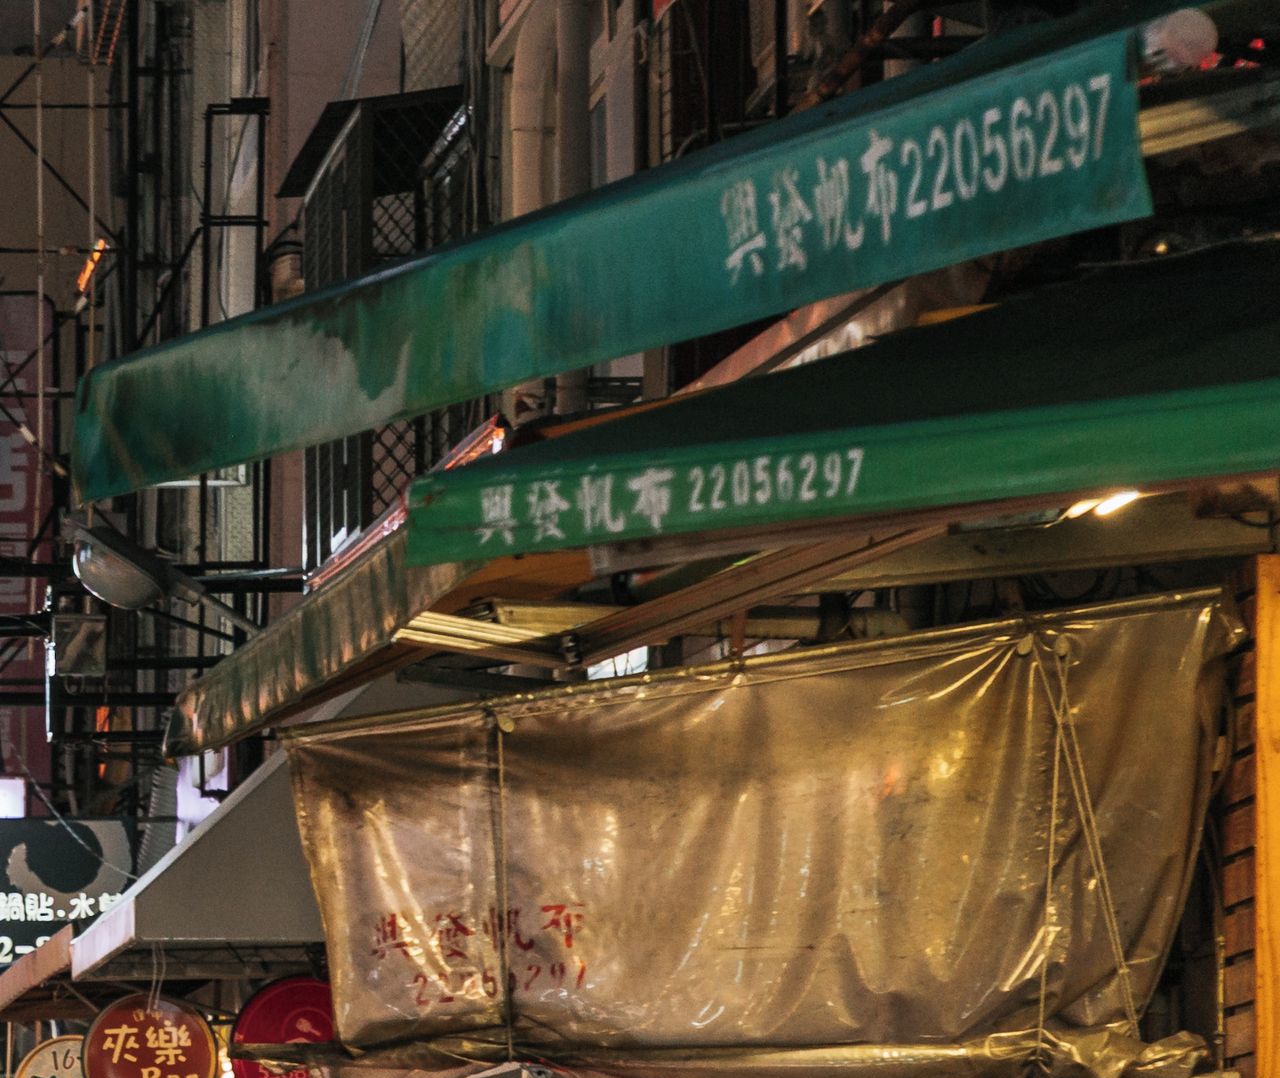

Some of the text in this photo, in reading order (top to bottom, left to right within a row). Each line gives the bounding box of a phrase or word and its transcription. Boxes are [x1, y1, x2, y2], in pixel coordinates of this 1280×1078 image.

[901, 74, 1110, 218] 22056297
[689, 448, 865, 512] 22056297
[102, 1022, 192, 1065] 夾樂
